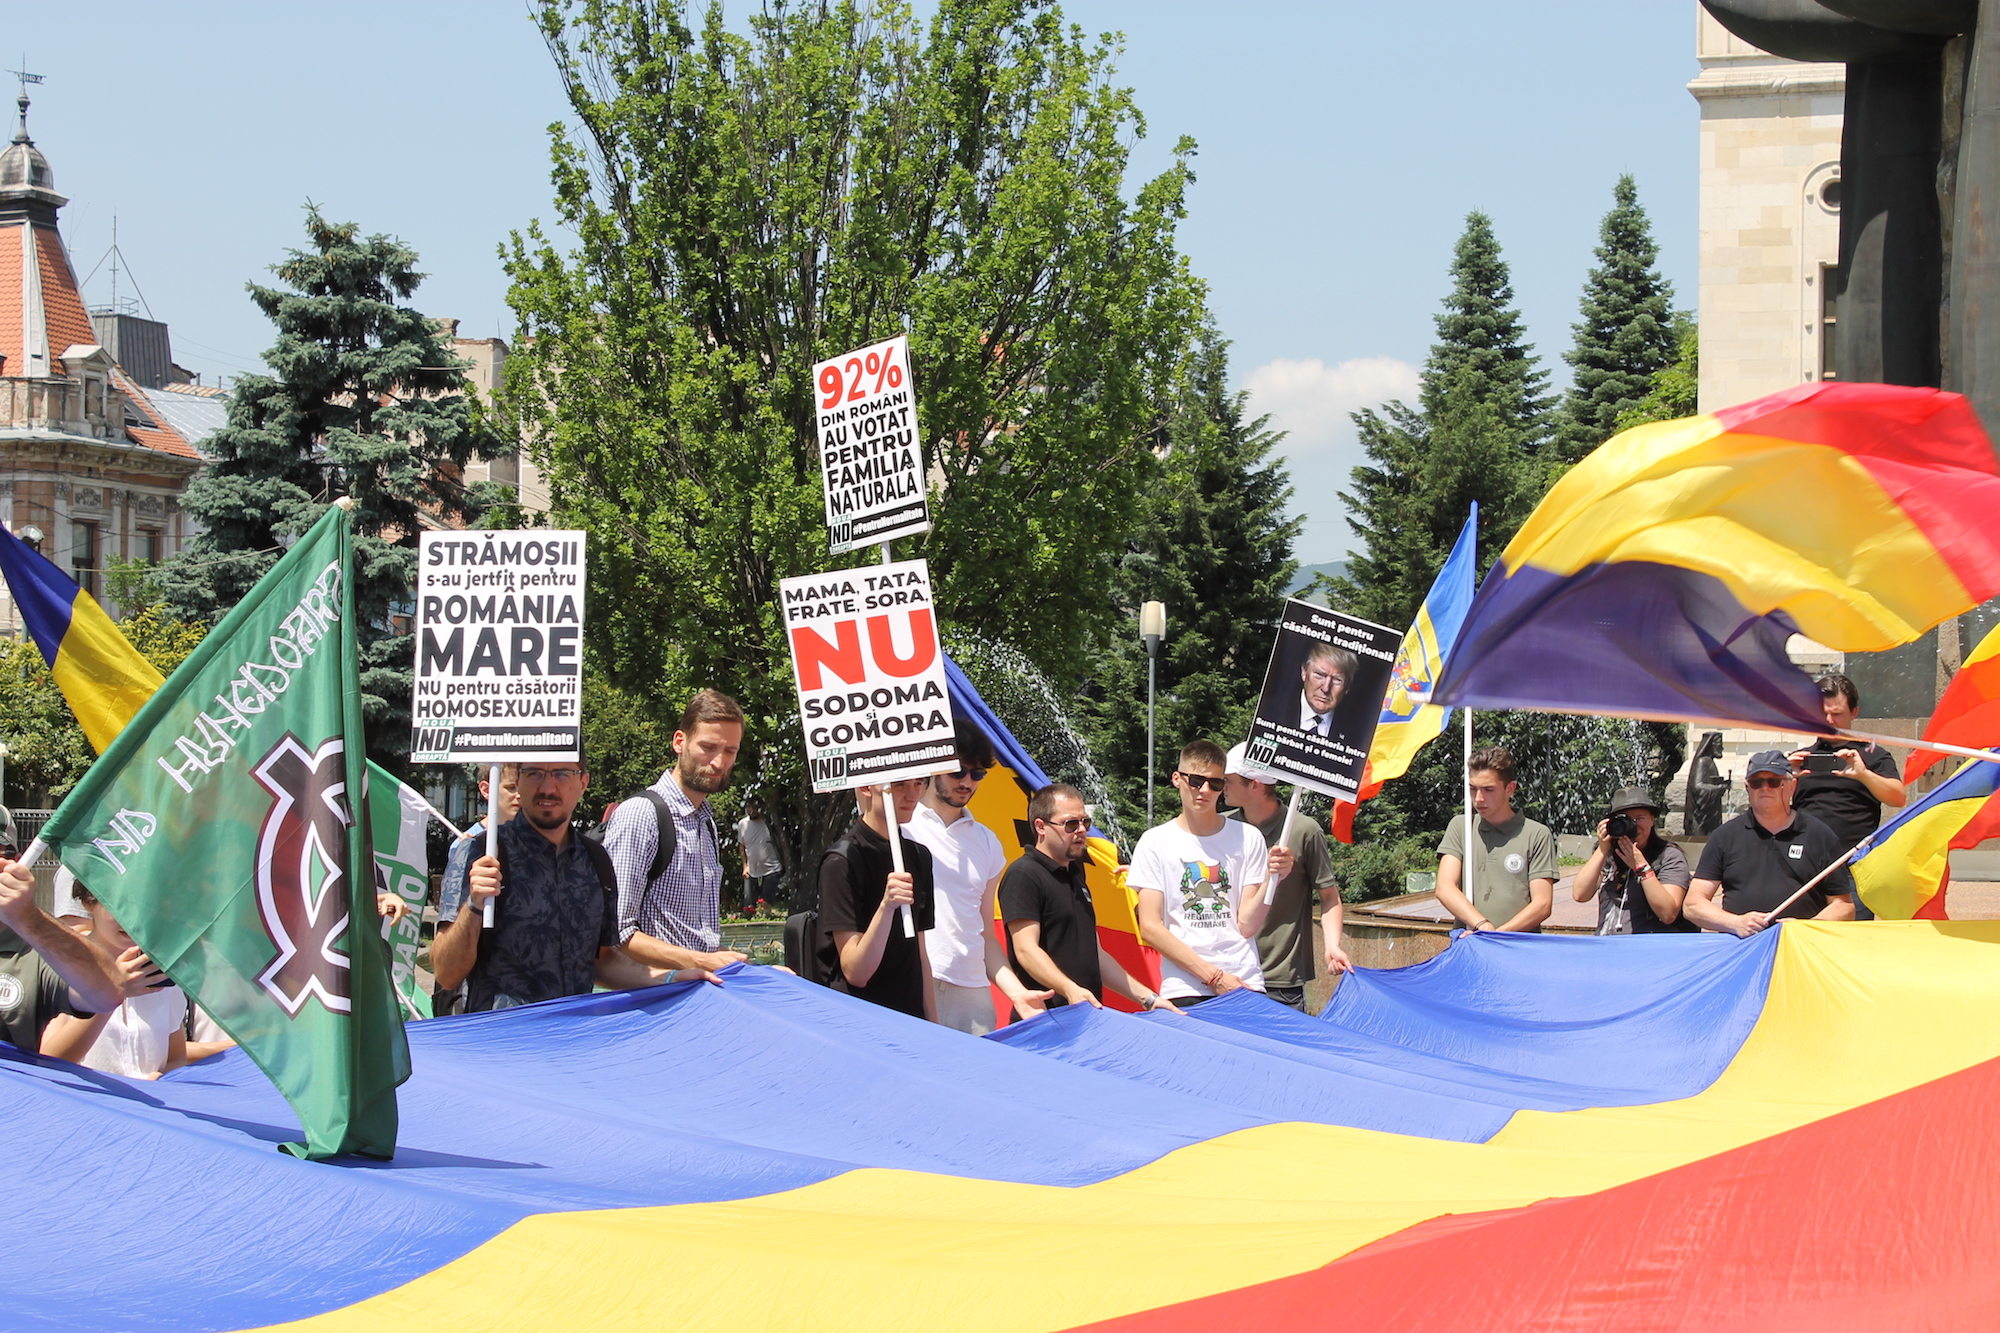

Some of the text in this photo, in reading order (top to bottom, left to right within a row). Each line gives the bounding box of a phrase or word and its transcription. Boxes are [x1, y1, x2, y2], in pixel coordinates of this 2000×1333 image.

[819, 346, 902, 409] 92%
[821, 391, 907, 428] DIN ROMÂNI
[824, 407, 909, 450] AU VOTAT
[825, 428, 912, 468] PENTRU
[827, 449, 915, 491] FAMILIA
[830, 464, 918, 517] NATURALĂ
[833, 523, 850, 545] ND
[852, 505, 924, 536] #PentruNormalitate
[426, 569, 576, 590] s-au jertfit pentru
[785, 571, 926, 604] MAMA, TATA,
[423, 586, 579, 625] ROMÂNIA
[788, 588, 928, 621] FRATE, SORA,
[1282, 620, 1395, 662] căsătoria tradițională
[1311, 614, 1375, 642] Sunt pentru
[420, 627, 579, 677] MARE
[791, 608, 936, 692] NU
[418, 677, 576, 699] NU pentru căsătorii
[804, 680, 944, 719] SODOMA
[417, 698, 575, 718] HOMOSEXUALE!
[422, 719, 454, 727] NOUA
[419, 729, 451, 751] ND
[454, 732, 574, 748] #PentruNormalitate
[810, 709, 949, 748] GOMORA
[1254, 736, 1279, 749] NOUA
[1256, 717, 1366, 759] Sunt pentru căsătoria între
[818, 747, 846, 758] NOUA
[848, 742, 955, 771] #PentruNormalitate
[1249, 743, 1274, 764] ND
[1263, 732, 1275, 740] un
[1276, 736, 1304, 751] bărbat
[1320, 749, 1353, 766] femeie!
[819, 757, 844, 780] ND
[1274, 755, 1358, 790] #PentruNormalitate
